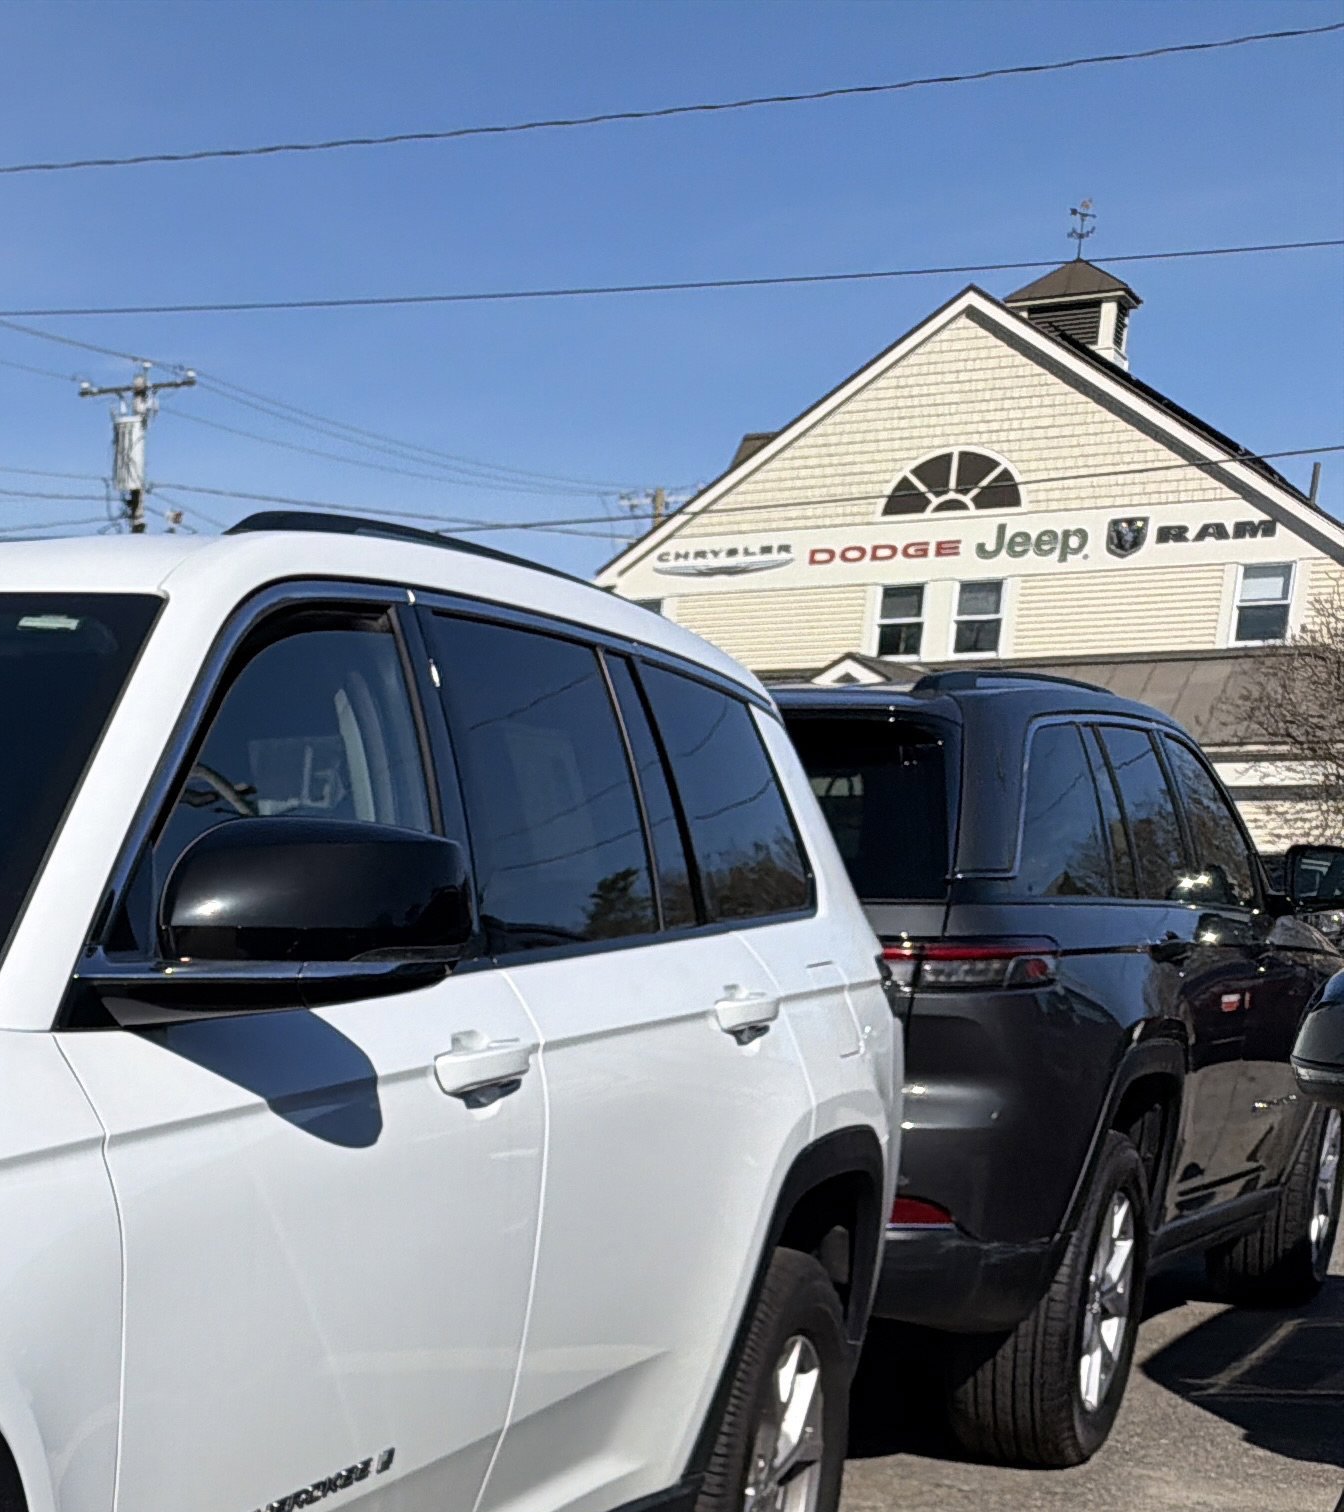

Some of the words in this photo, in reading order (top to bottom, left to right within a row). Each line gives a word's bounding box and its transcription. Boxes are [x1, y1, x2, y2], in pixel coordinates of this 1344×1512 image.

[656, 543, 793, 563] CHRYSLER
[808, 539, 962, 566] DODGE
[975, 522, 1089, 563] Jeep
[1155, 519, 1278, 545] RAM
